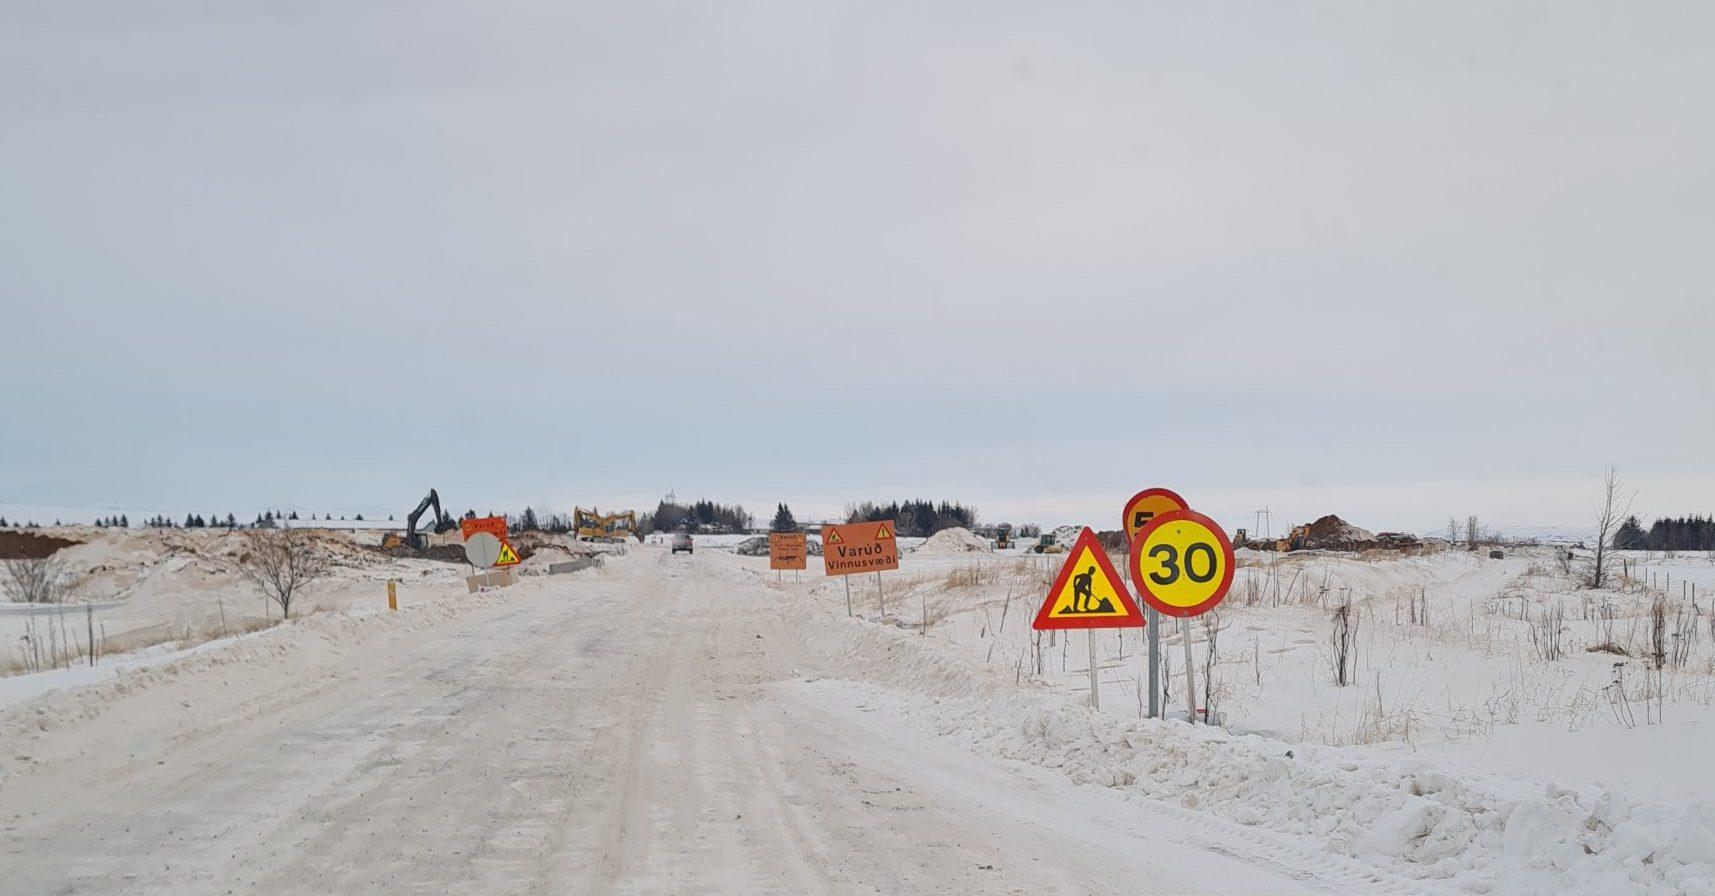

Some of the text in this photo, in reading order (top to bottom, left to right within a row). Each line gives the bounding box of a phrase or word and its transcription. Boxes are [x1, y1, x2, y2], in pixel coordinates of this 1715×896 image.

[838, 543, 882, 557] Varúð
[828, 555, 896, 570] Vinnusvæði
[1148, 542, 1218, 585] 30
